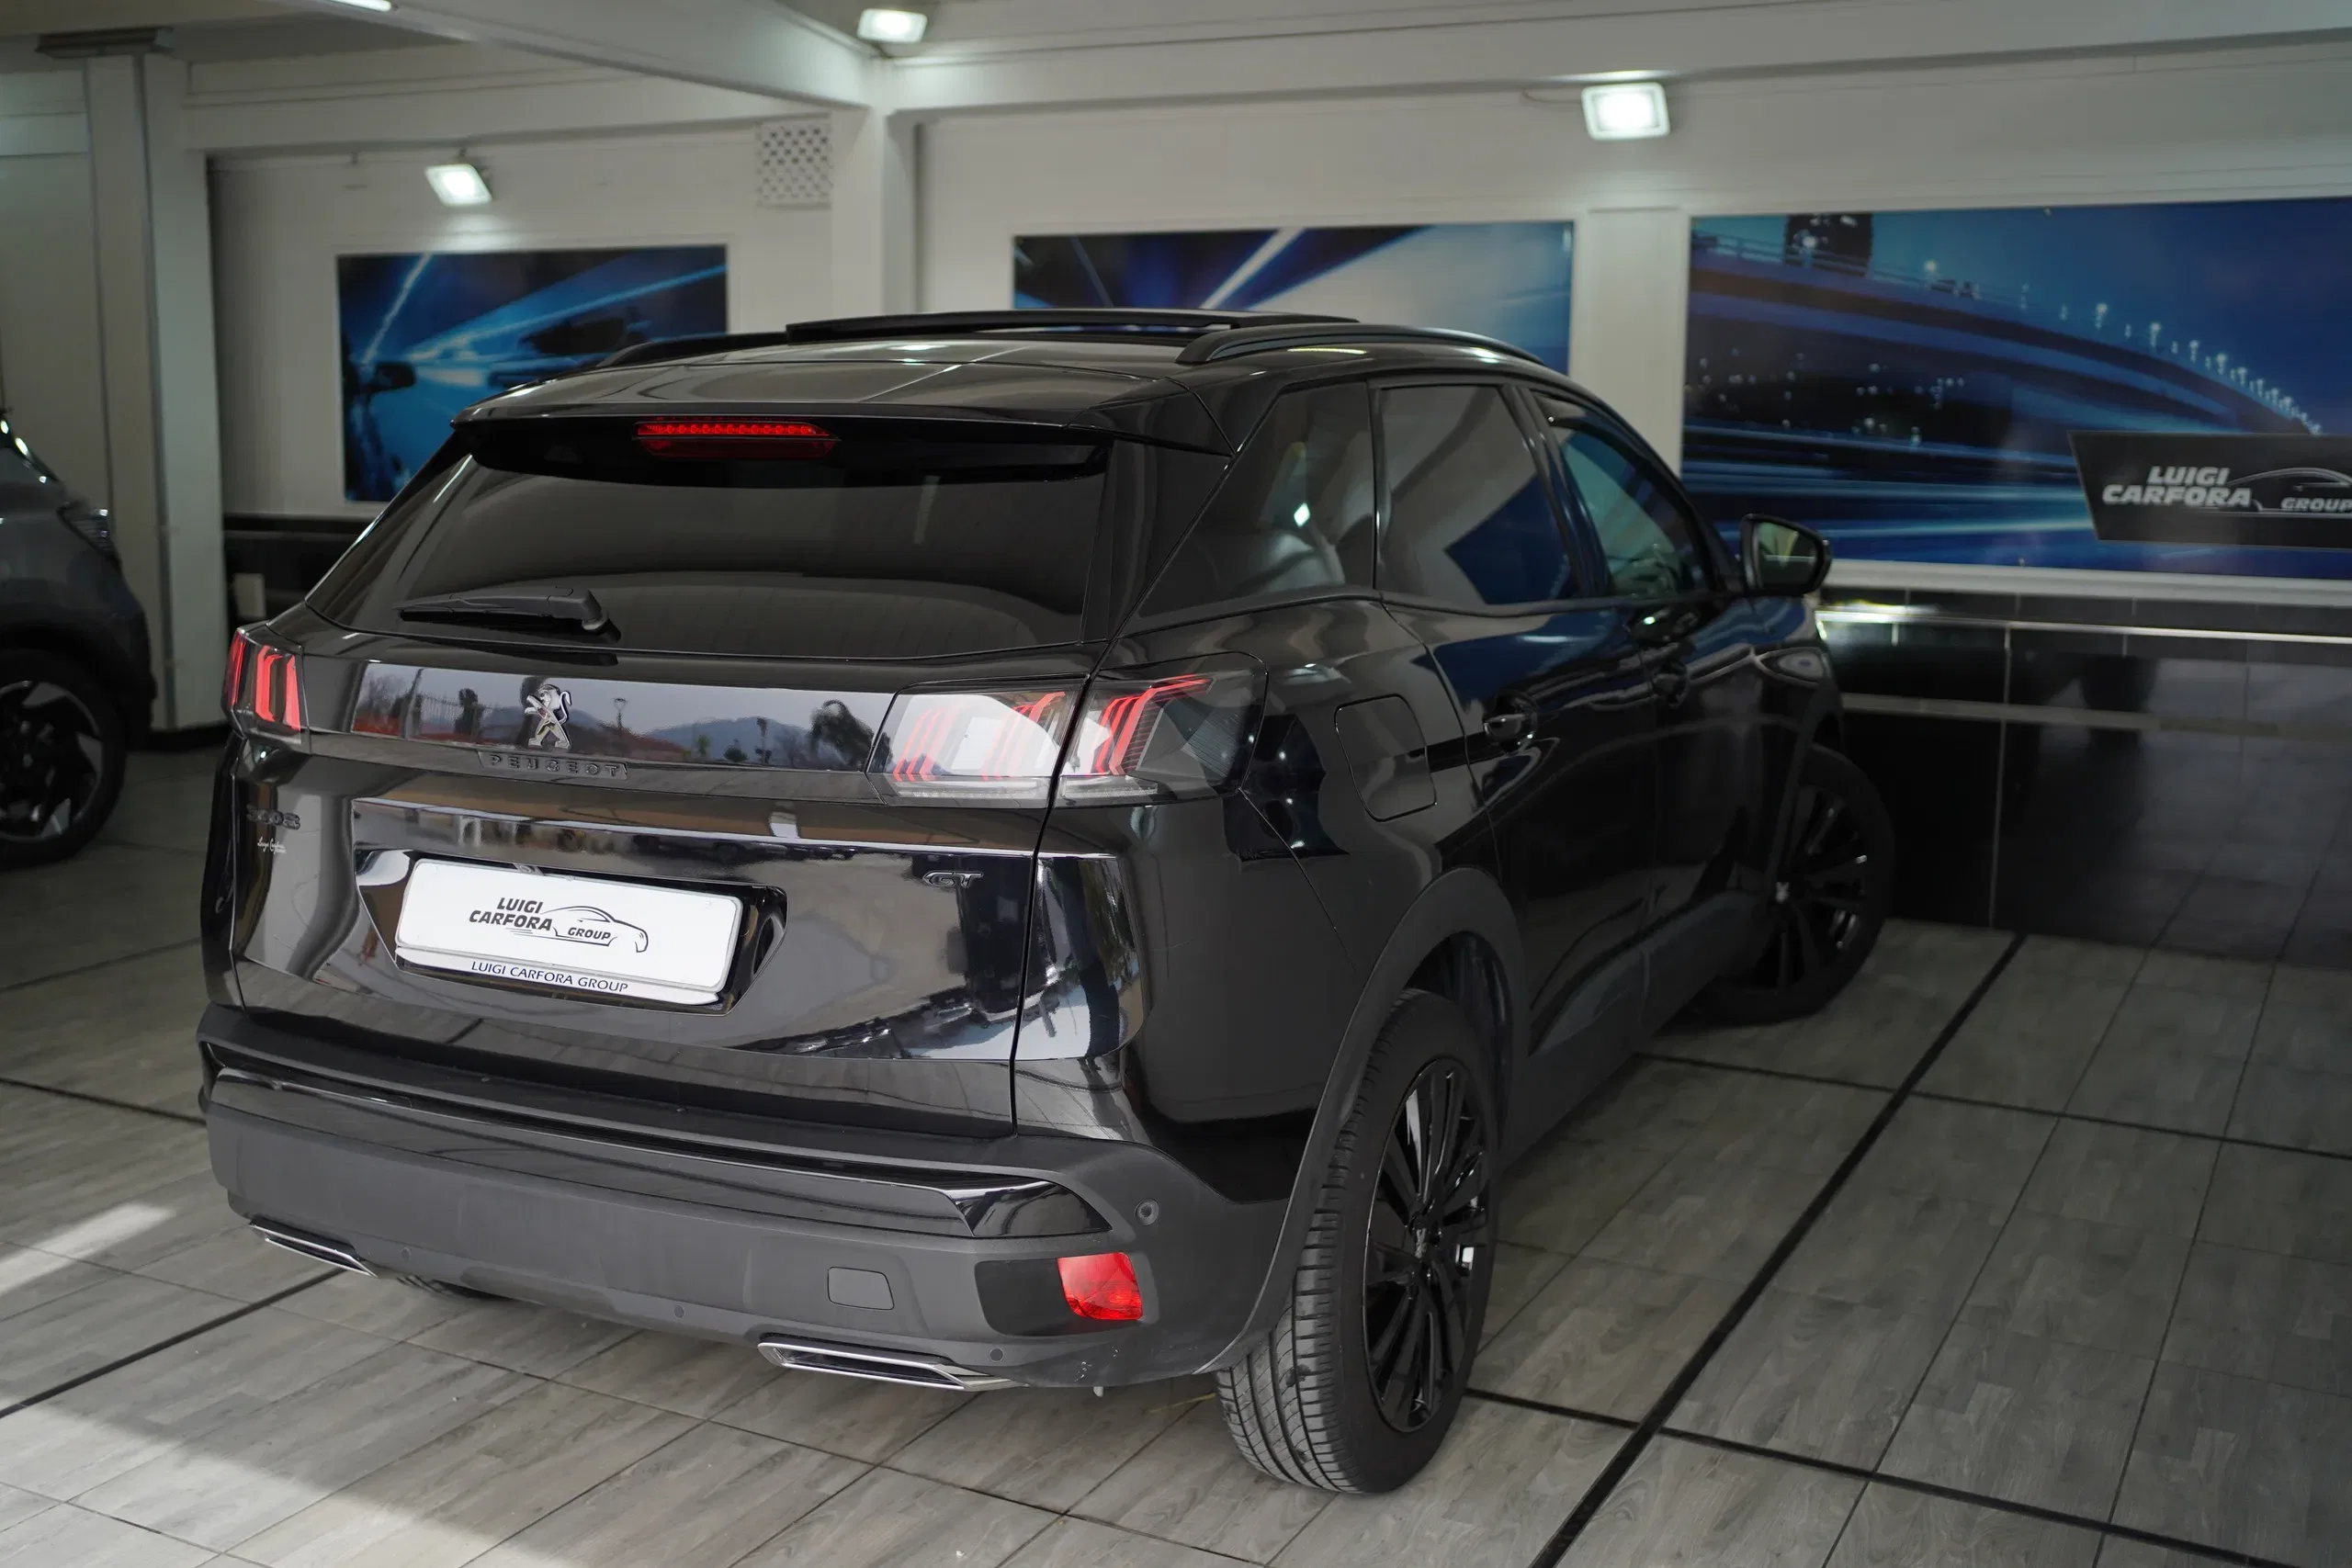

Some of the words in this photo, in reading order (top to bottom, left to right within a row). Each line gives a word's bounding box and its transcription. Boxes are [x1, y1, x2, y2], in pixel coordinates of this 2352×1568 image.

[2147, 466, 2230, 486] LUIGI
[2102, 484, 2252, 507] CARFORA
[489, 754, 618, 777] PEUGEOT
[922, 870, 984, 887] GT
[496, 897, 544, 914] LUIGI
[469, 909, 553, 931] CARFORA
[567, 927, 611, 941] GROUP
[471, 961, 506, 975] LUIGI
[510, 966, 573, 985] CARFORA
[578, 976, 628, 992] GROUP
